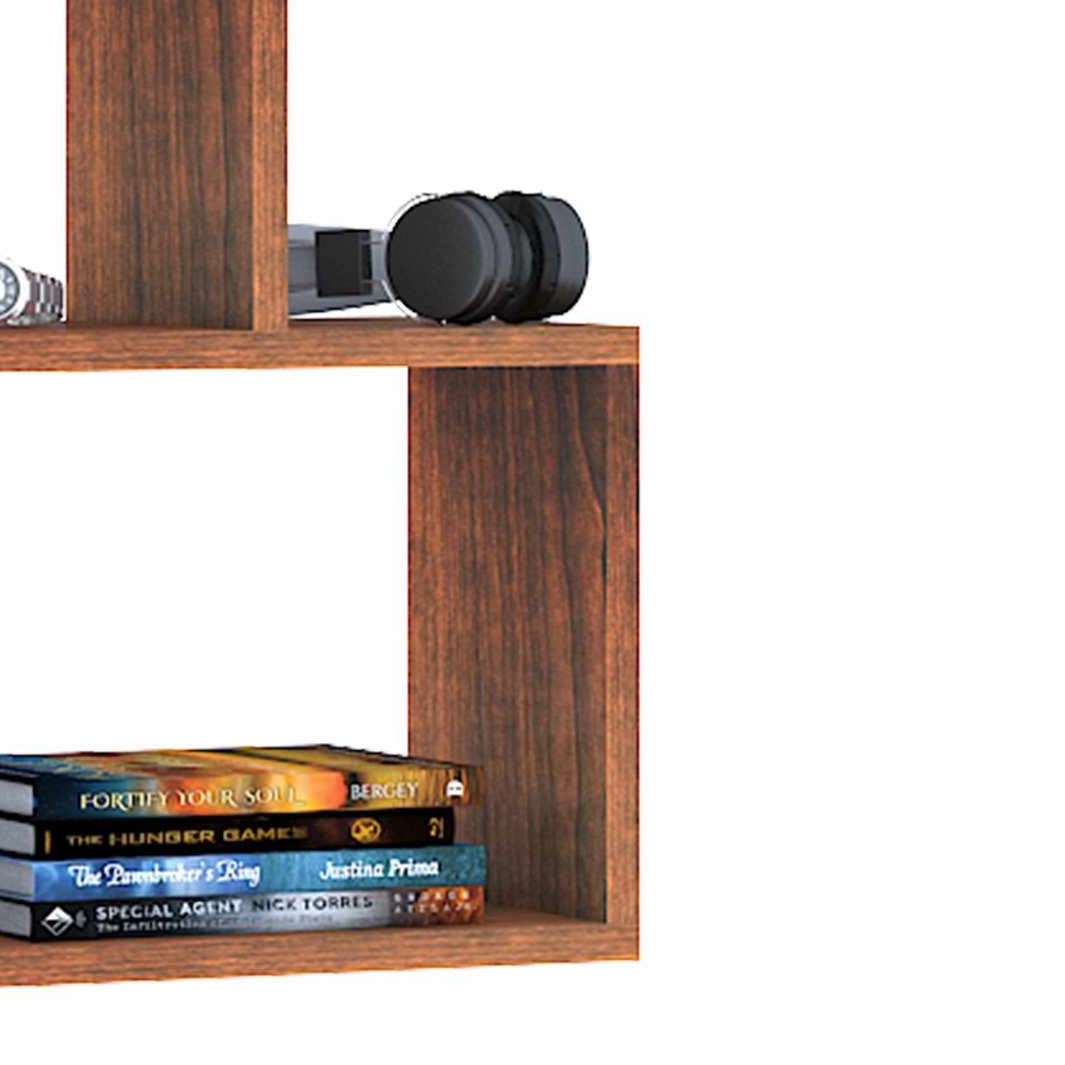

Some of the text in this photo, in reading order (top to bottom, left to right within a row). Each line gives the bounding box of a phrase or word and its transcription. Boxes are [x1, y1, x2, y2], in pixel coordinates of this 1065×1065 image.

[80, 785, 305, 812] FORTIFY YOUR SOUL
[350, 782, 419, 800] BERGEY
[66, 834, 103, 847] THE
[109, 829, 216, 846] HUNGER
[68, 859, 262, 887] The Pawnbroker's Ring
[319, 857, 440, 881] Justina Prima
[96, 895, 374, 921] SPECIAL AGENT NICK TORRES
